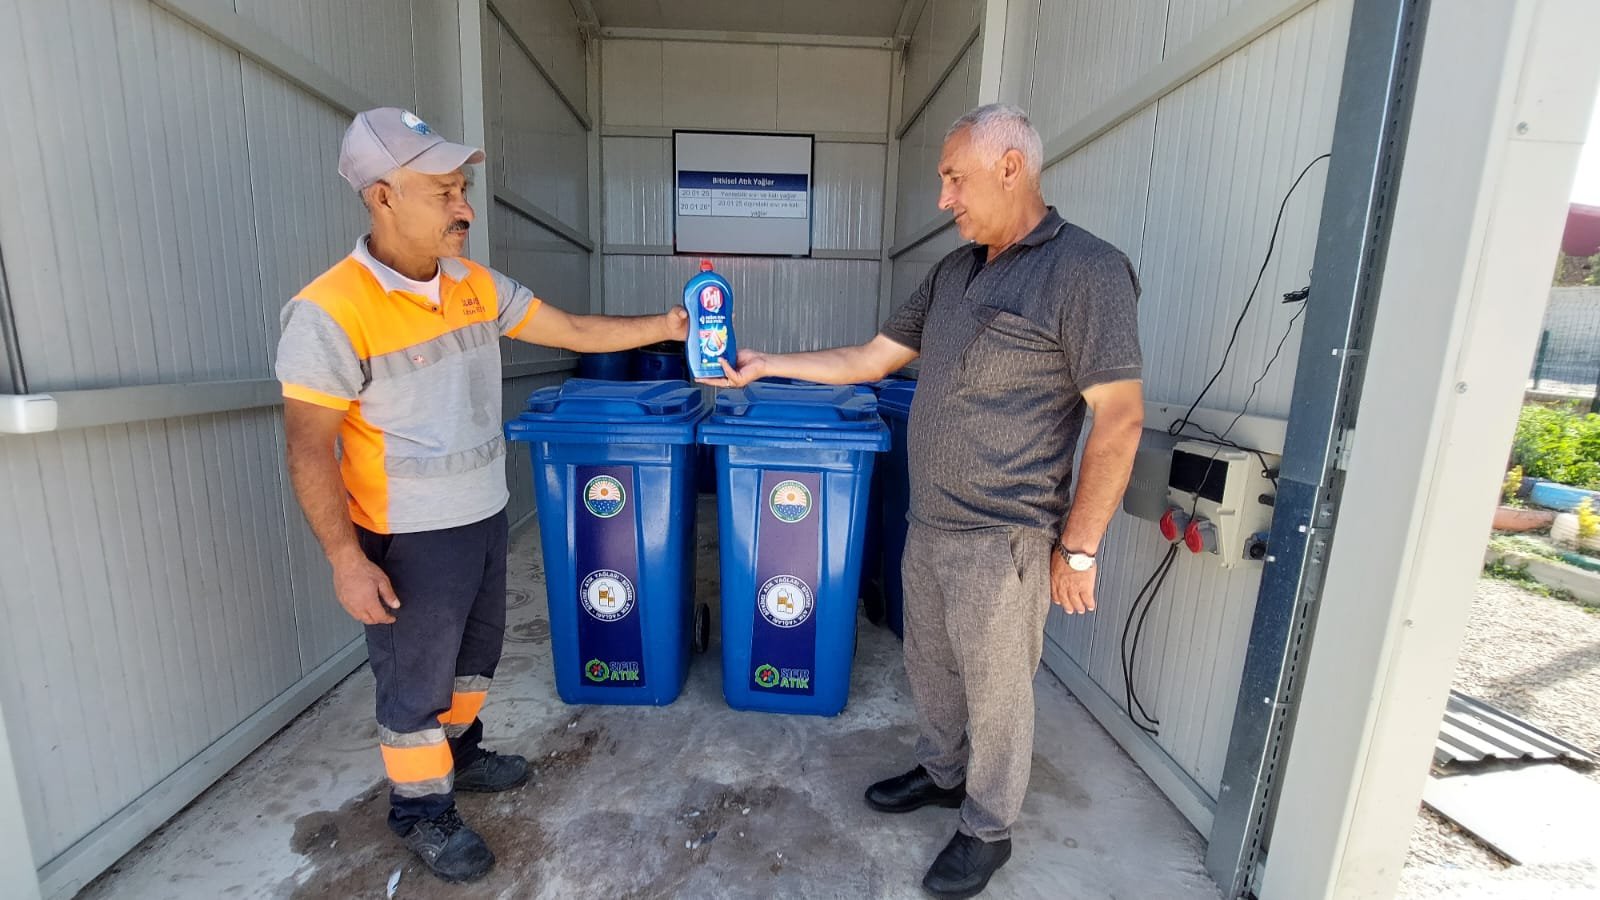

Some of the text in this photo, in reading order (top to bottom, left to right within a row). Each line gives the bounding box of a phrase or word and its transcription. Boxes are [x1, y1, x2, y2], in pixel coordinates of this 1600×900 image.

[738, 177, 752, 185] Atık
[753, 178, 775, 187] Yağlar
[610, 671, 640, 681] ATIK
[780, 677, 809, 689] ATIK
